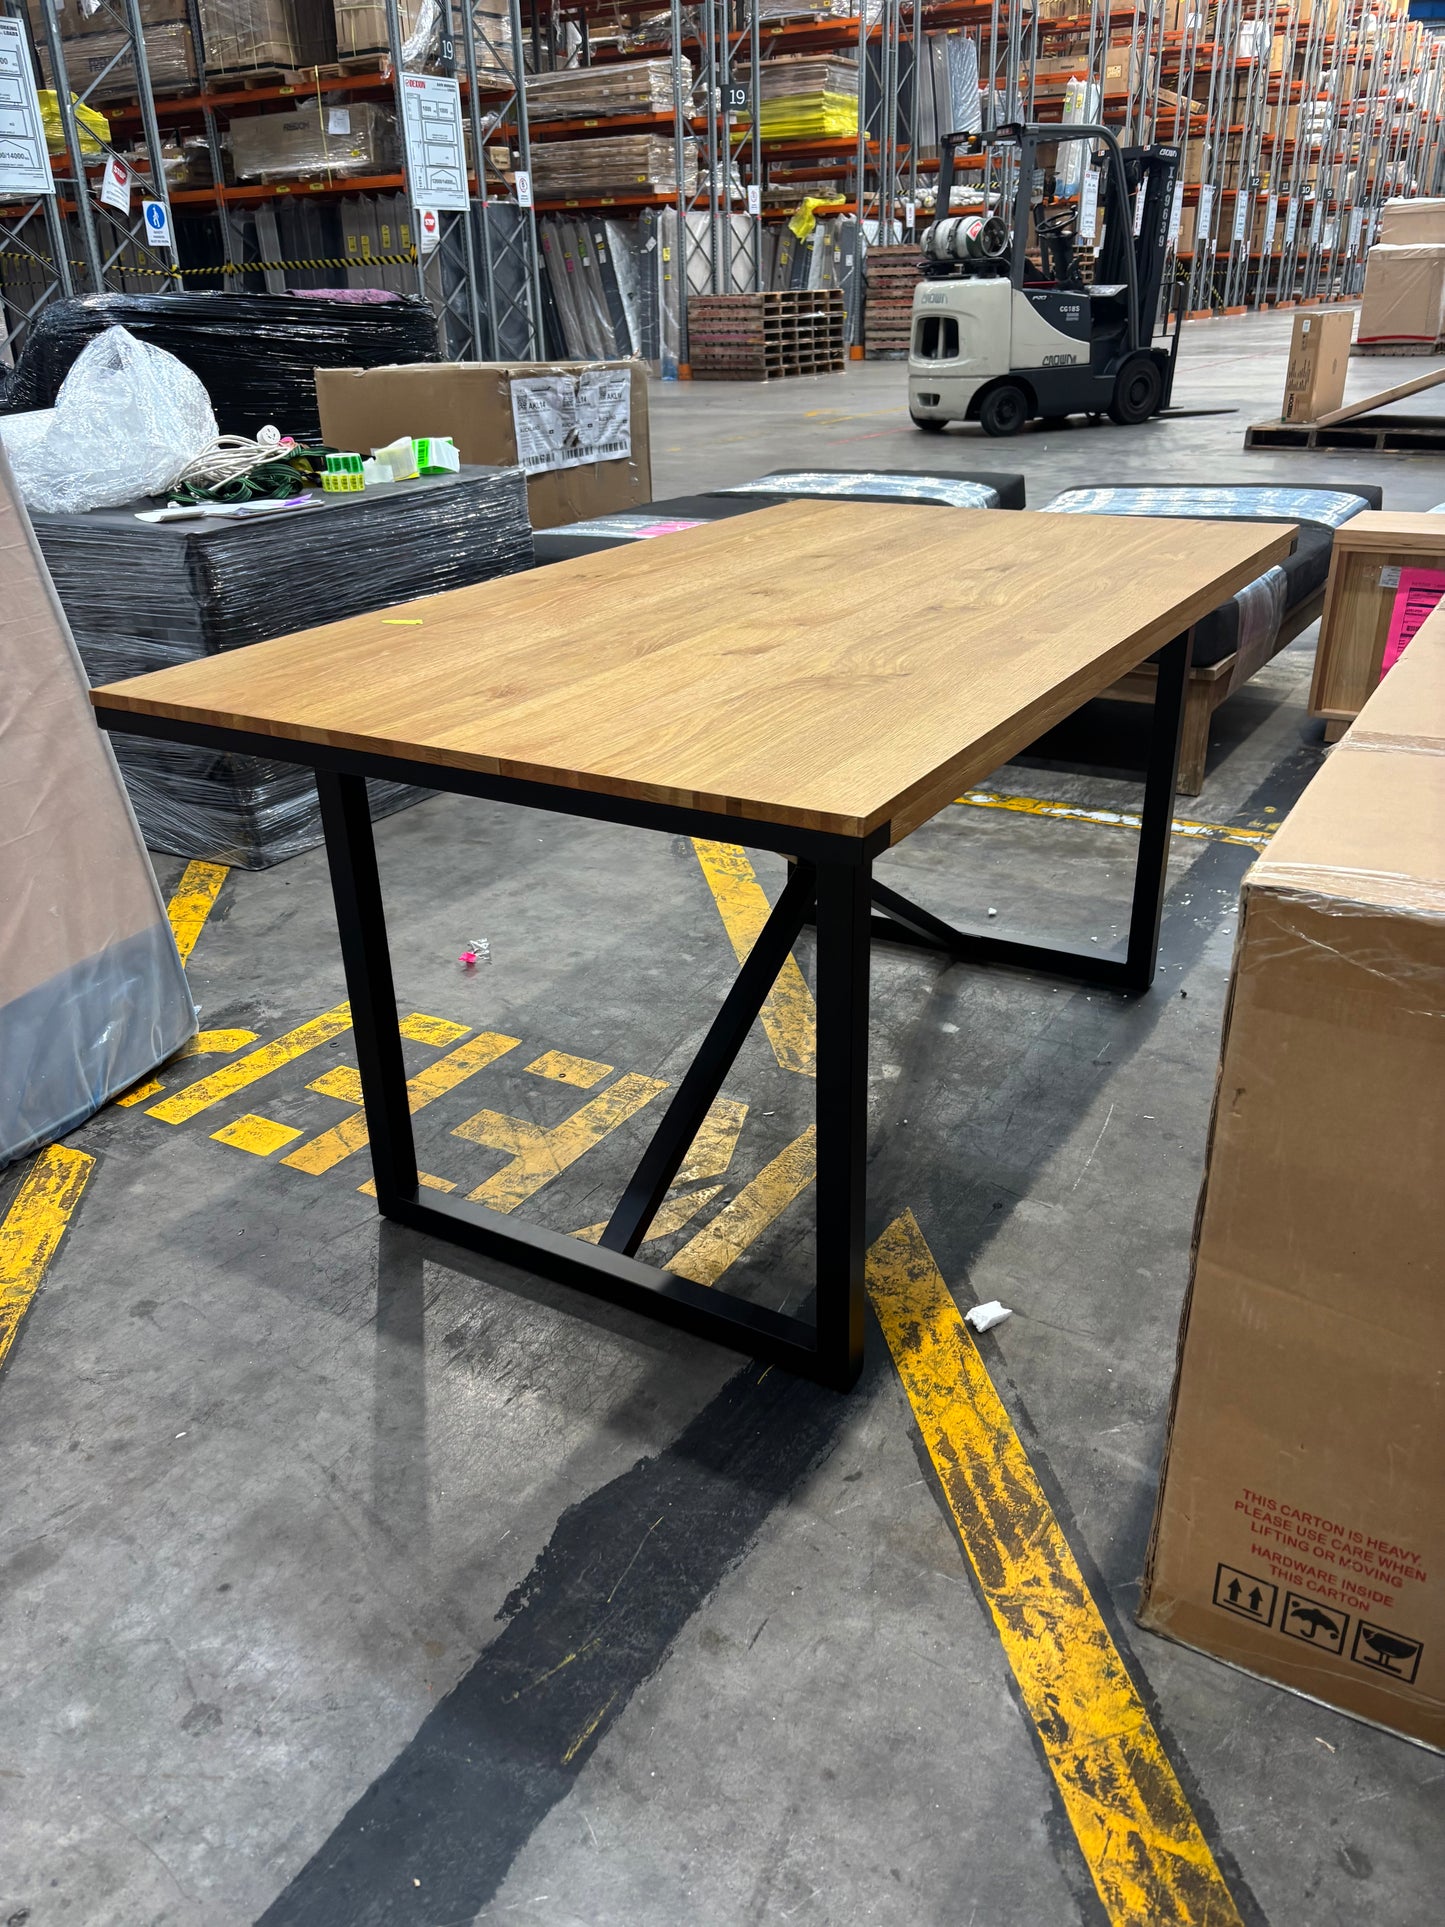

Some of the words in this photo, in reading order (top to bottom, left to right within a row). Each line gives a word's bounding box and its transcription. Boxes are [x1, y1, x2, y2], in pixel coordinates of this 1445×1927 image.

[442, 40, 453, 60] 19
[730, 89, 746, 105] 19
[1252, 178, 1260, 186] 12
[1302, 186, 1311, 194] 10
[1042, 354, 1074, 367] CROWN
[1243, 1488, 1277, 1510] THIS
[1280, 1505, 1345, 1536] CARTON
[1348, 1530, 1363, 1543] IS
[1234, 1500, 1292, 1531] PLEASE
[1296, 1525, 1328, 1545] USE
[1331, 1539, 1374, 1563] CARE
[1378, 1556, 1427, 1582] WHEN
[1250, 1521, 1309, 1552] LIFTING
[1313, 1546, 1335, 1563] OR
[1339, 1556, 1403, 1588] MOVING
[1250, 1543, 1337, 1585] HARDWARE
[1341, 1579, 1394, 1608] INSIDE
[1270, 1564, 1303, 1586] THIS
[1306, 1580, 1370, 1612] CARTON
